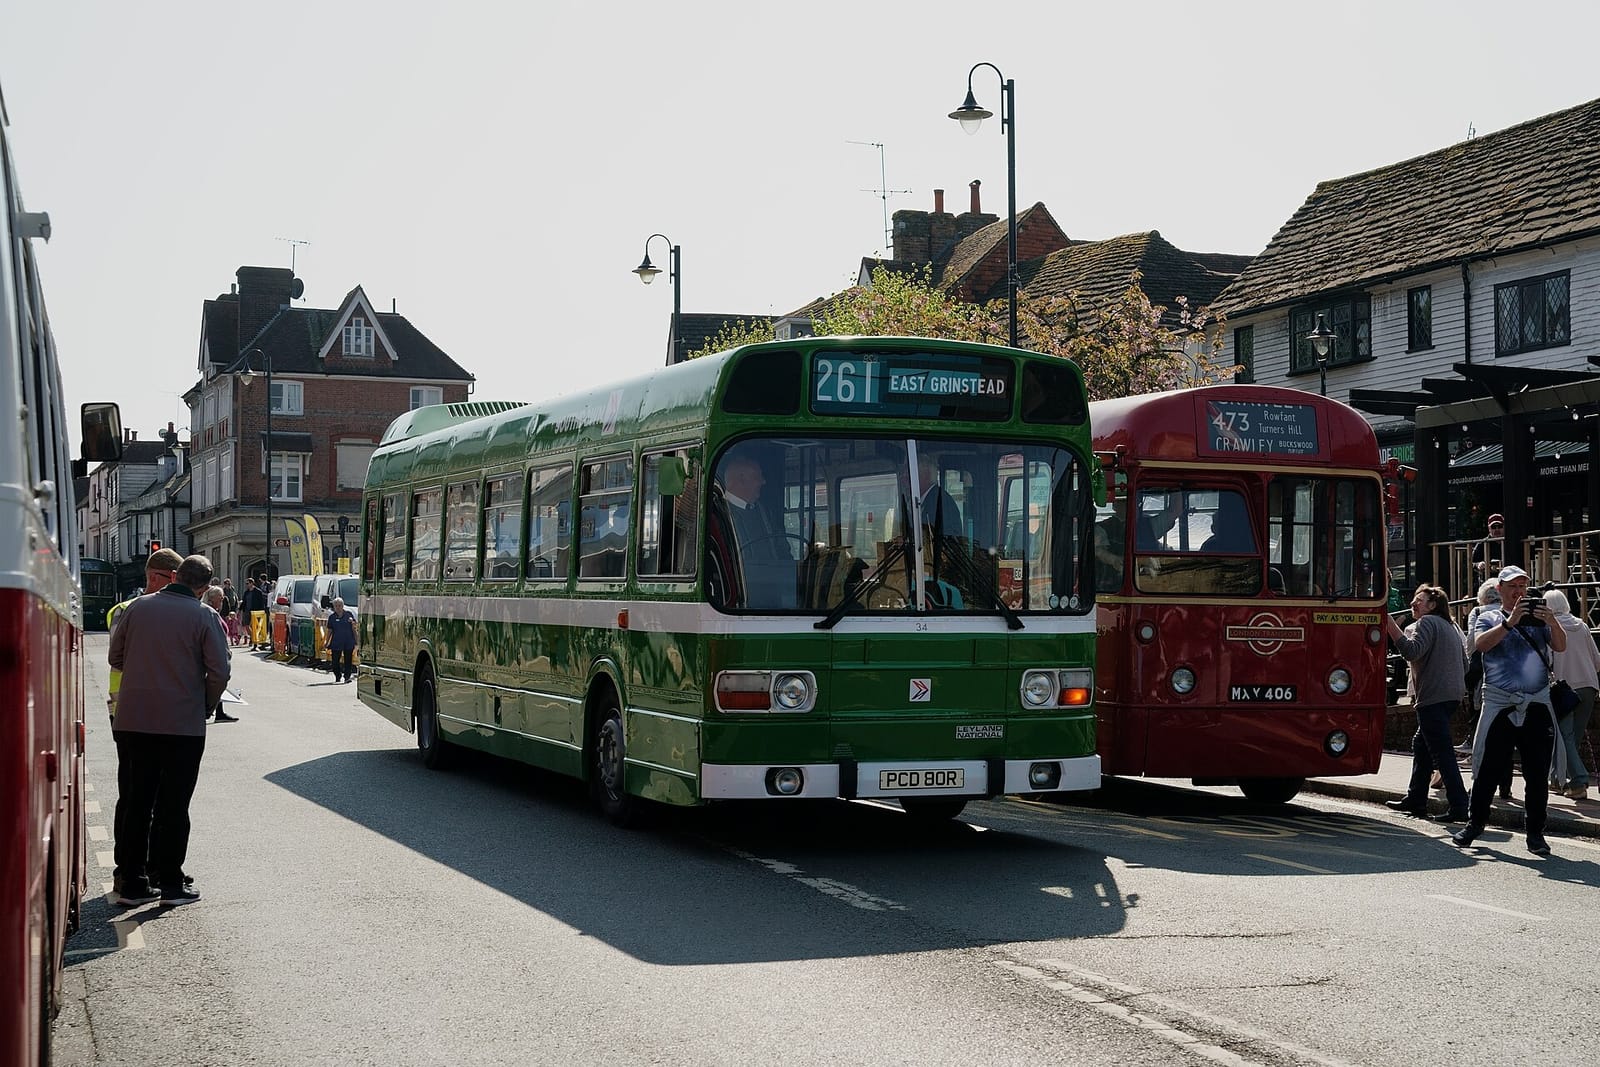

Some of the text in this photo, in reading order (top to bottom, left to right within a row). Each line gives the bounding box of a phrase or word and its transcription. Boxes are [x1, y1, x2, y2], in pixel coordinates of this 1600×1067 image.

[817, 359, 871, 403] 261
[890, 375, 1005, 394] EAST GRINSTEAD
[1212, 412, 1250, 431] 473
[1264, 410, 1296, 422] Rowfant
[1258, 423, 1302, 435] Turners Hill
[1279, 440, 1313, 449] BUCKSWOOD
[1393, 445, 1414, 463] PRICE
[1540, 466, 1558, 475] MORE
[1560, 464, 1576, 473] THAN
[1261, 630, 1301, 638] TRANSPORT
[1264, 687, 1293, 700] 406
[886, 771, 957, 787] PCD 80R
